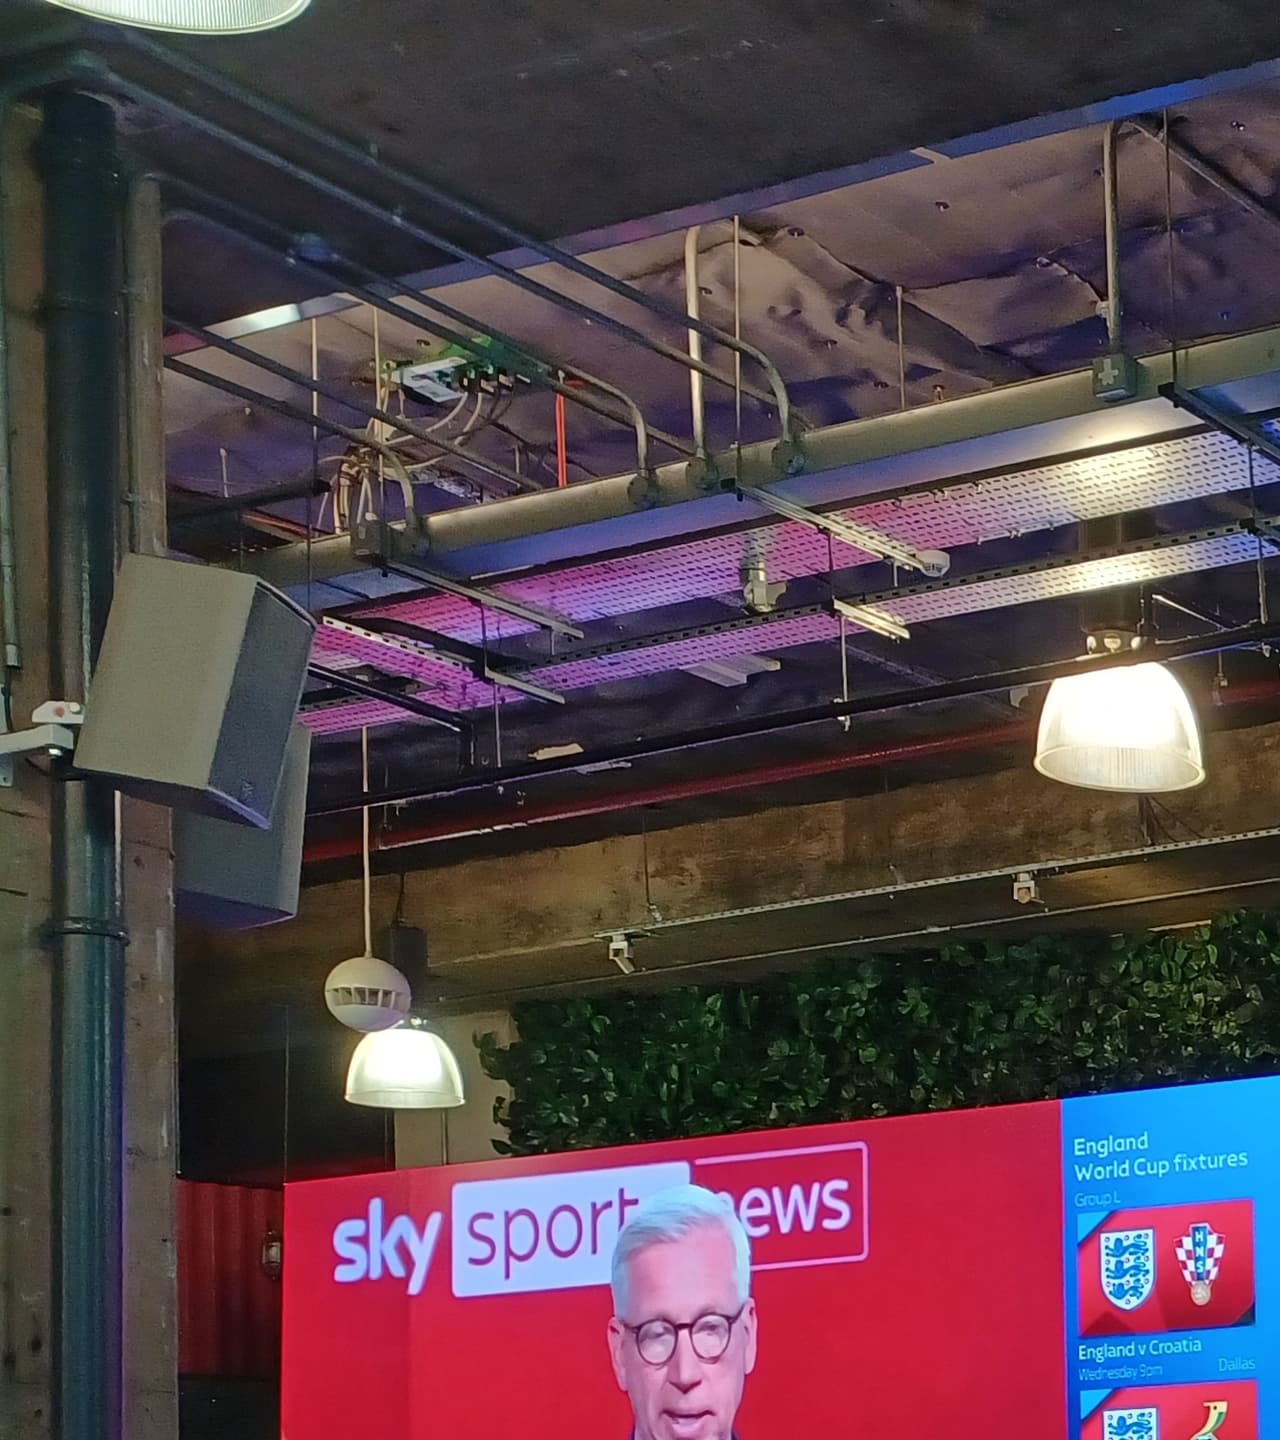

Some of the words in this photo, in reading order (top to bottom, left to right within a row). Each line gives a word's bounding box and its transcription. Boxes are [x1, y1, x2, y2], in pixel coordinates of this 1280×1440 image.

[1074, 1131, 1149, 1156] England
[1074, 1160, 1129, 1181] World
[1134, 1157, 1170, 1177] Cup
[1173, 1151, 1248, 1171] fixtures
[1074, 1192, 1112, 1207] Group
[333, 1197, 442, 1295] sky
[467, 1187, 639, 1279] sport
[718, 1179, 851, 1237] ews
[1078, 1341, 1135, 1362] England
[1138, 1344, 1146, 1355] v
[1149, 1337, 1202, 1354] Croatia
[1079, 1366, 1137, 1381] Wednesday
[1218, 1358, 1256, 1372] Dallas
